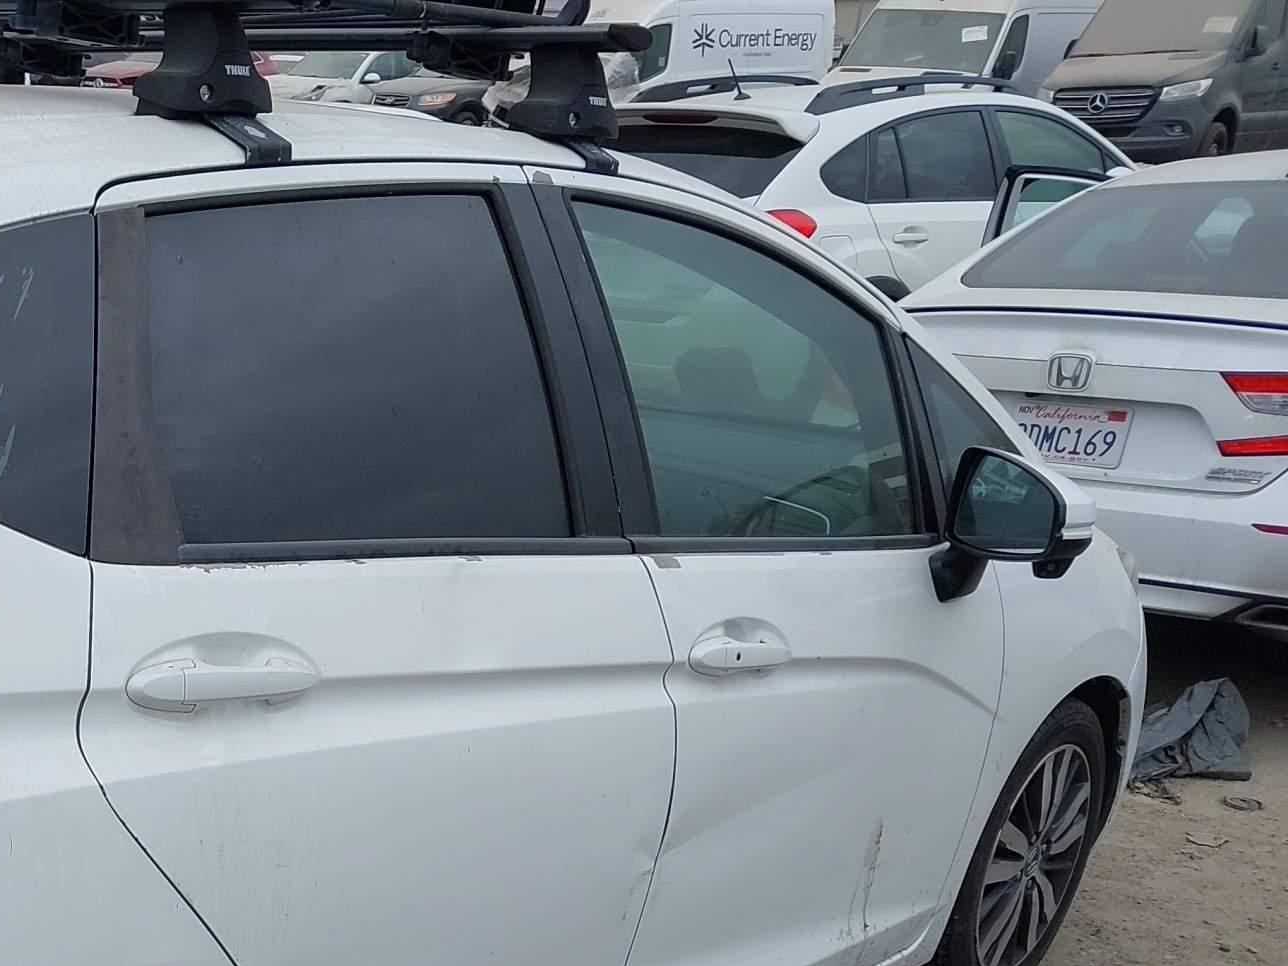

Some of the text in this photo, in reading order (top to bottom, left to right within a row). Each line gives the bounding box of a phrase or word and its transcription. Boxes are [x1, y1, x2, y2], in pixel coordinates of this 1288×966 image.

[718, 28, 817, 51] Current Energy
[224, 64, 251, 77] THULE
[1018, 404, 1107, 424] NOV California
